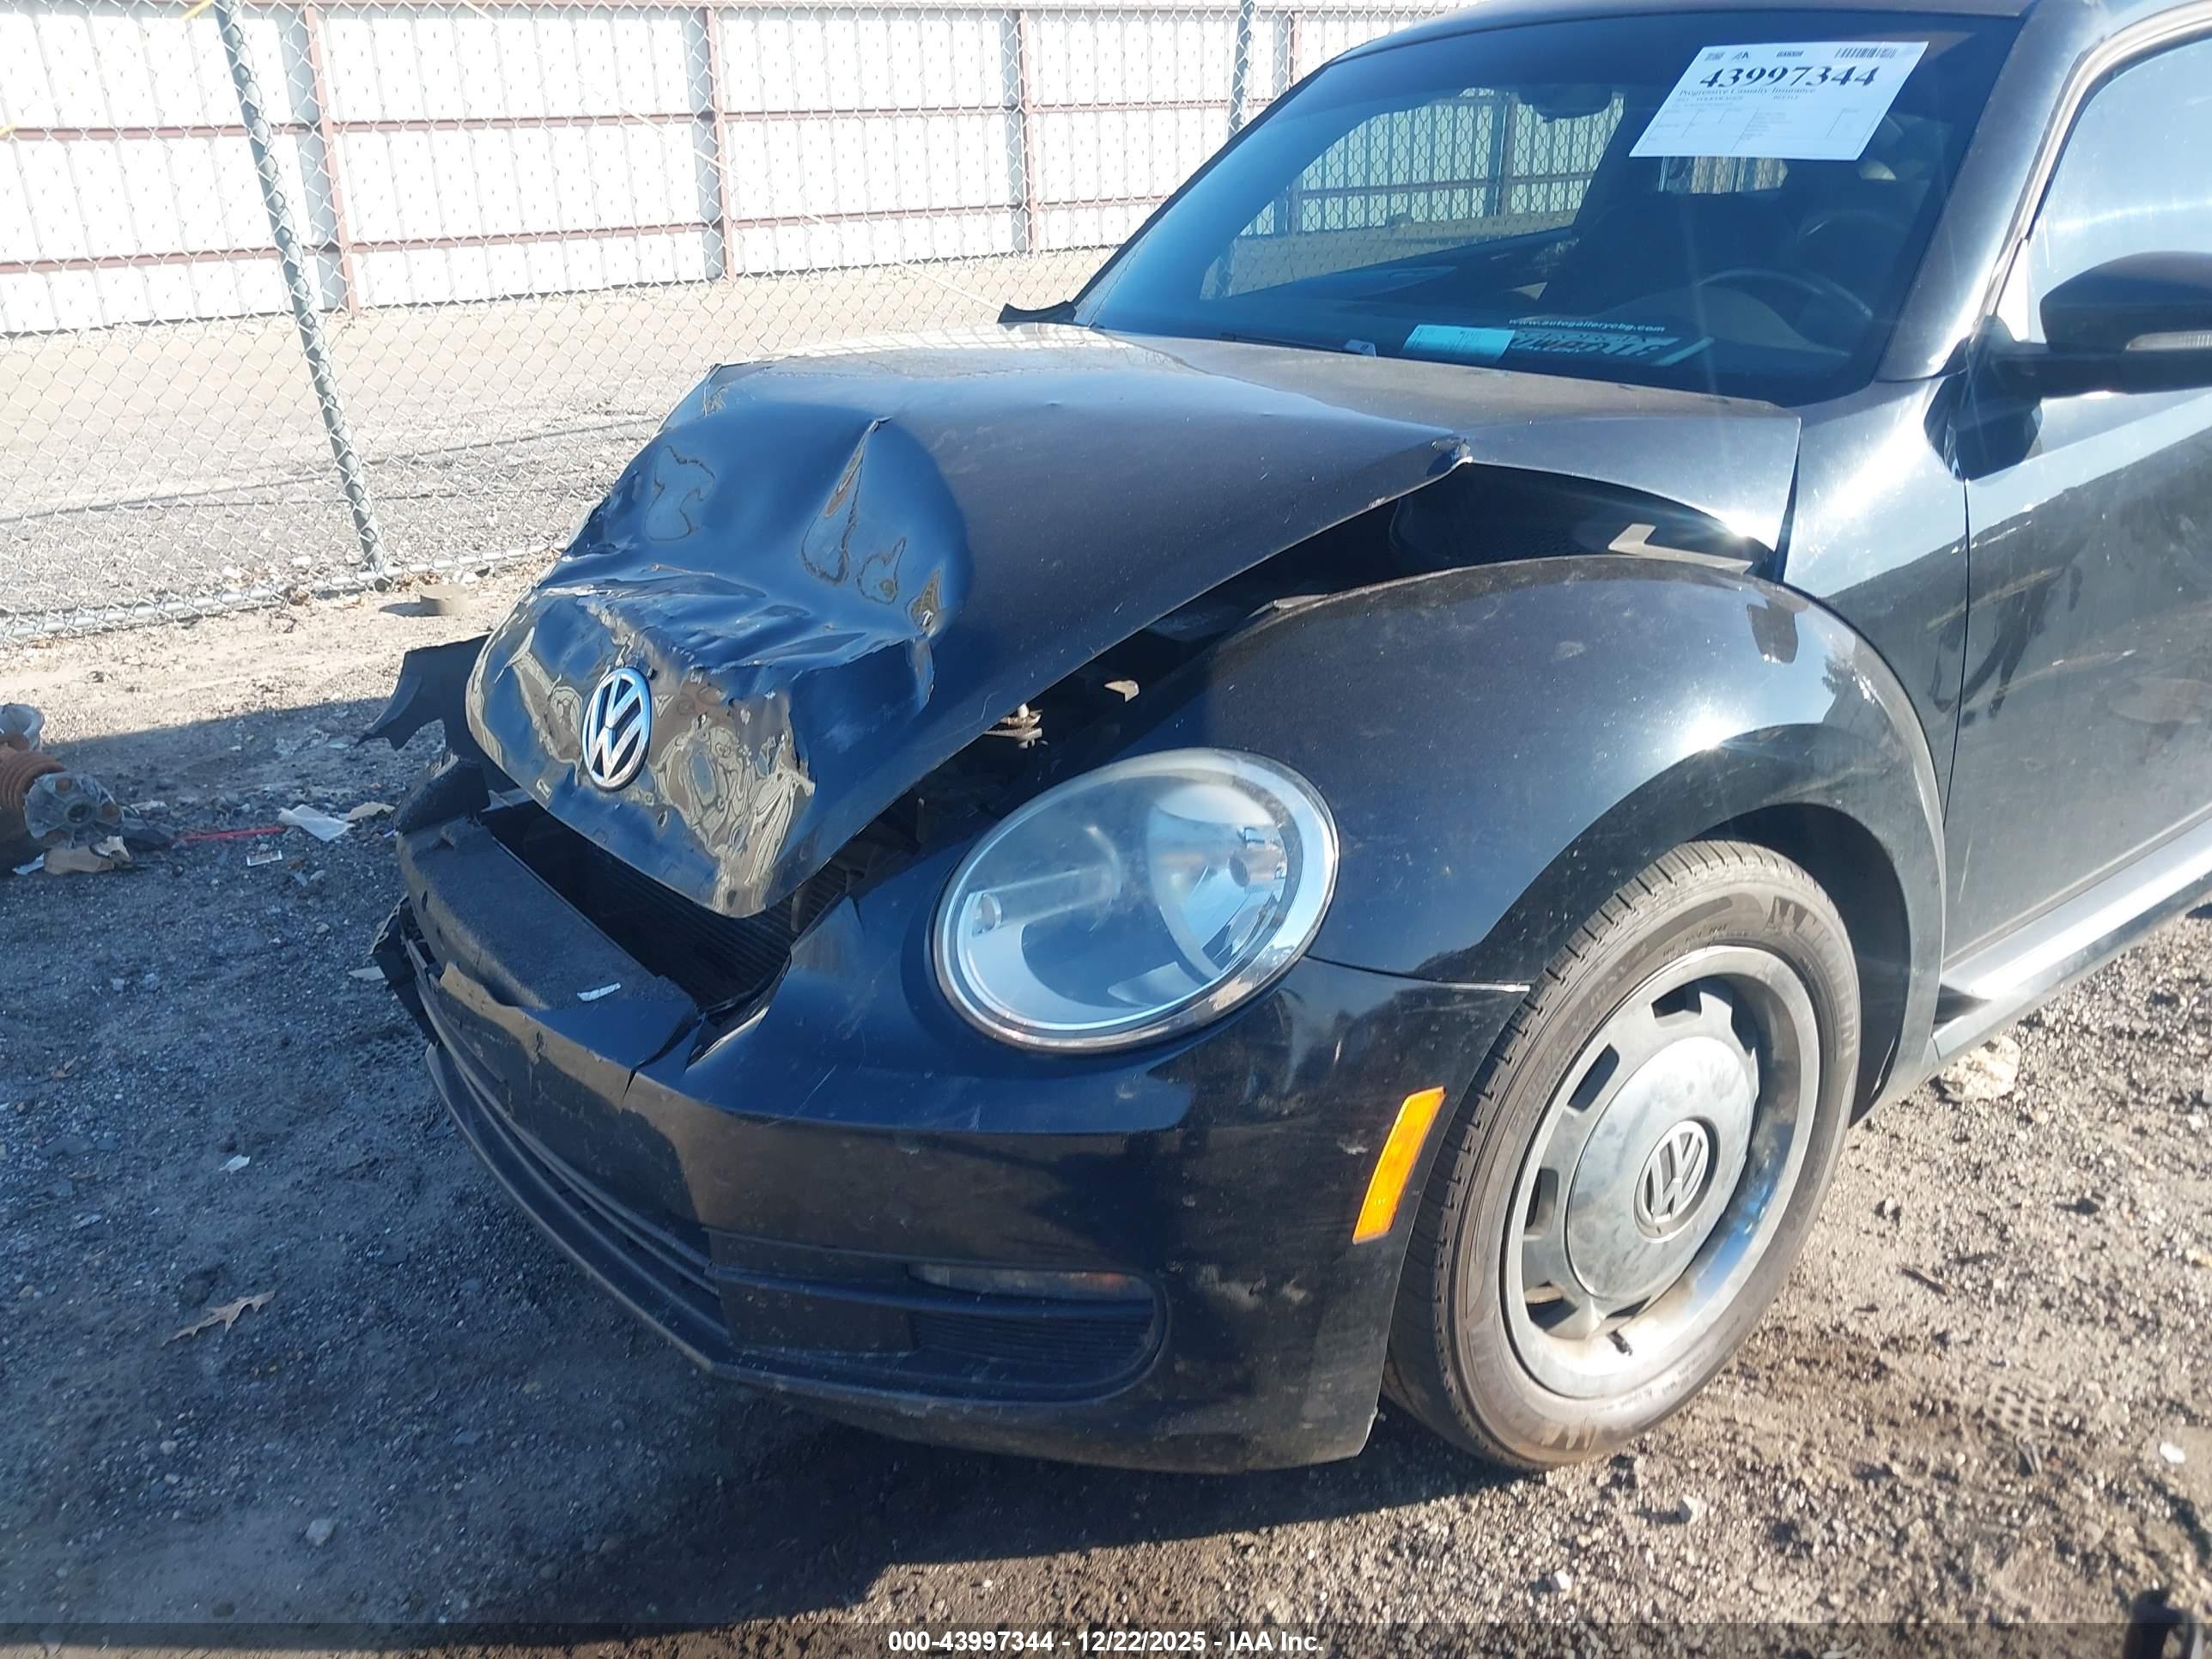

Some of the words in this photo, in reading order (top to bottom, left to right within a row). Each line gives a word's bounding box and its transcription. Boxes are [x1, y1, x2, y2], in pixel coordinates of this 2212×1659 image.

[1699, 65, 1881, 88] 43997344
[1679, 88, 1729, 96] Progressive
[1771, 86, 1815, 94] Insurance
